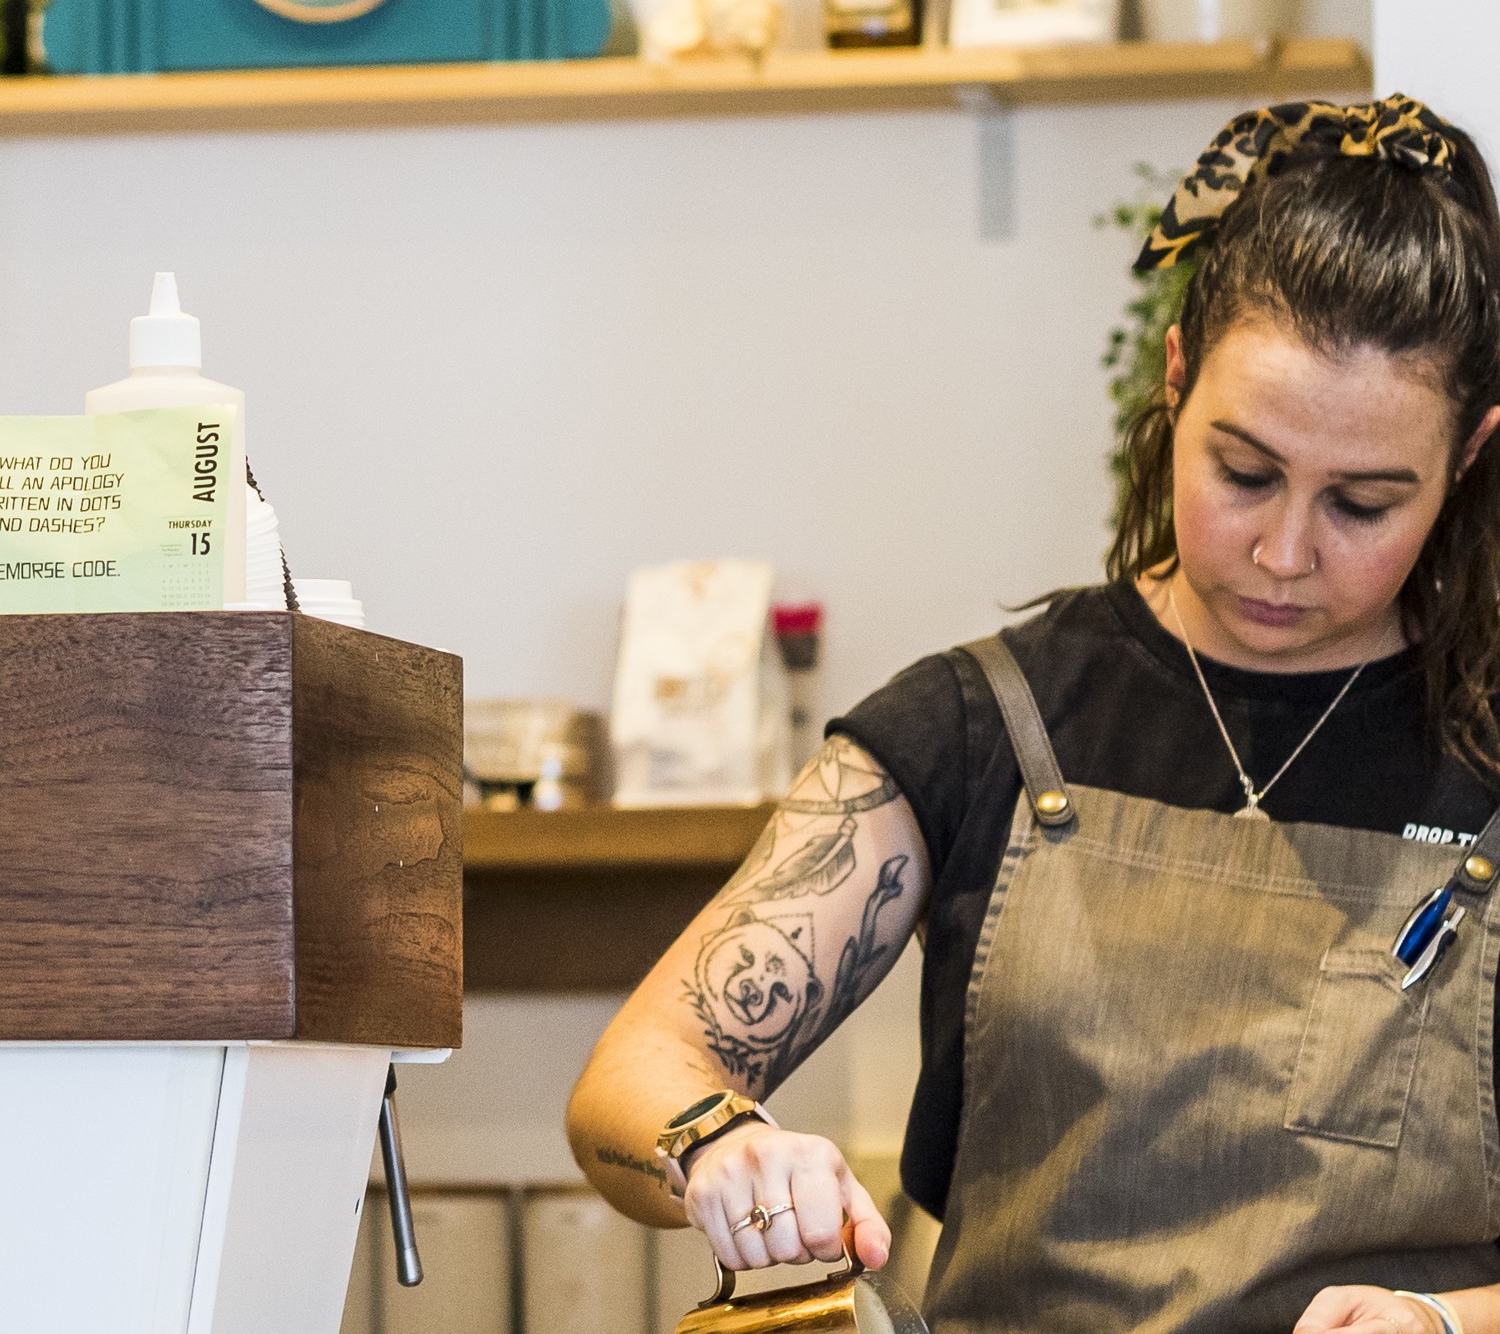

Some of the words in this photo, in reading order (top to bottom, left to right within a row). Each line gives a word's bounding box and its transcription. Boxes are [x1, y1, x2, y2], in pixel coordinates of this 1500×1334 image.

[0, 456, 43, 471] WHAT
[49, 456, 73, 471] DO
[81, 453, 111, 471] YOU
[192, 422, 220, 503] AUGUST
[21, 476, 44, 491] AN
[50, 473, 125, 492] APOLOGY
[56, 497, 73, 512] IN
[80, 494, 121, 513] DOTS
[28, 516, 106, 534] DASHES?
[168, 519, 213, 529] THURSDAY
[191, 532, 211, 555] 15
[72, 560, 120, 579] CODE.
[1402, 823, 1454, 845] DROP
